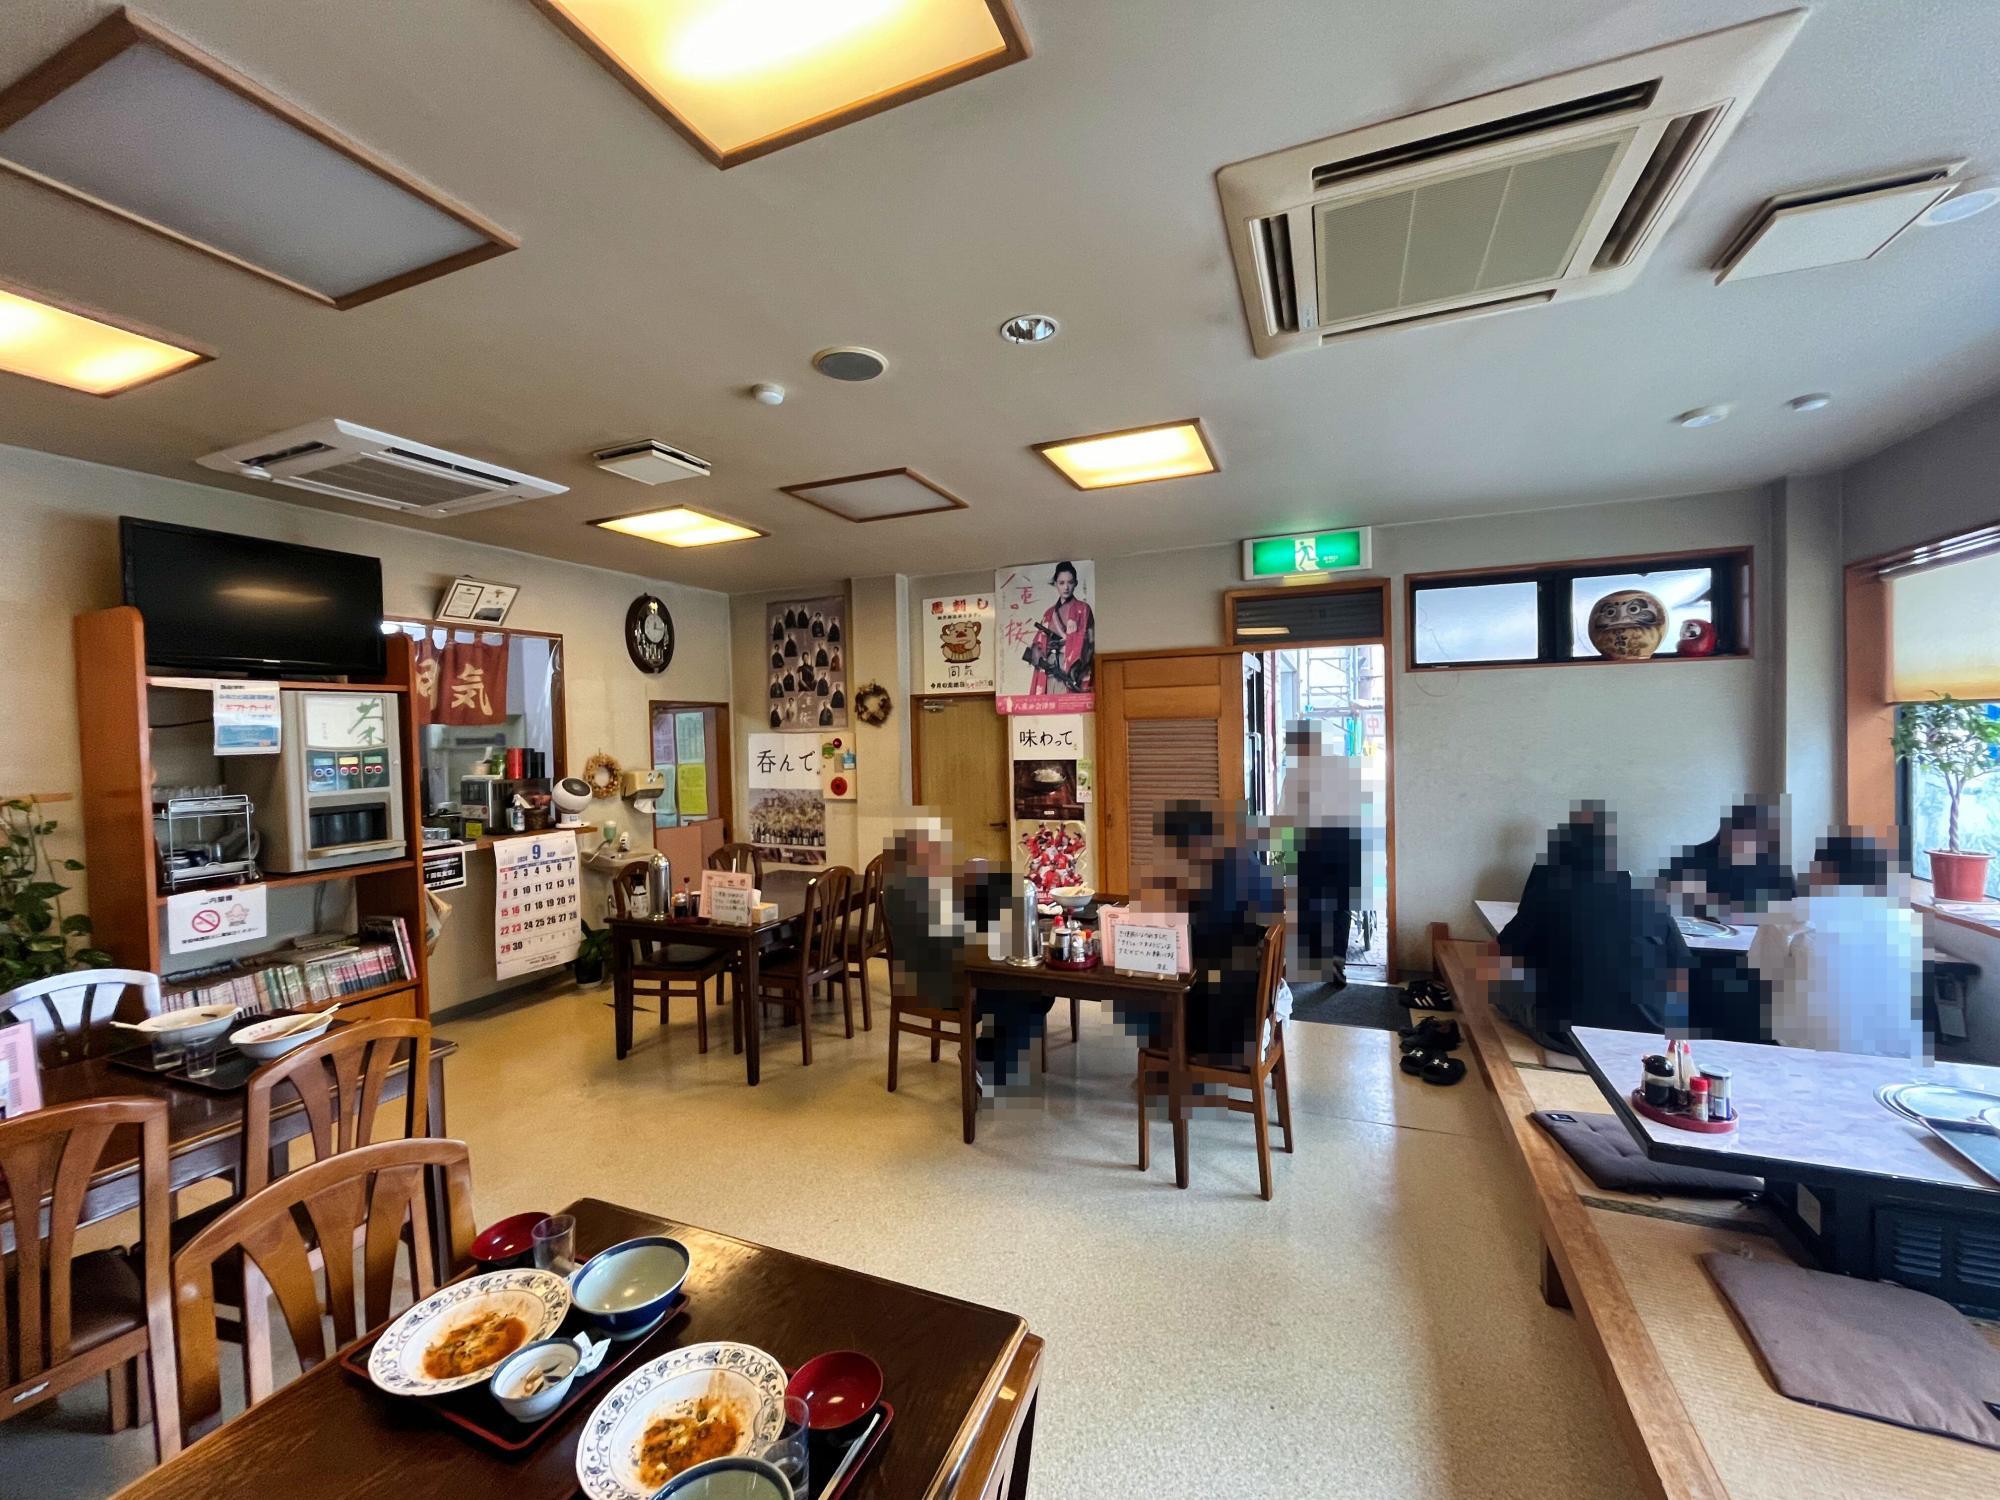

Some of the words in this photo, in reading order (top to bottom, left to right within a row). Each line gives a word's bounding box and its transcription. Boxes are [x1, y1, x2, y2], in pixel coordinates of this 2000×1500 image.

[931, 598, 989, 615] 馬刺し
[532, 844, 541, 860] 9
[513, 870, 518, 879] 2
[523, 868, 528, 877] 3
[535, 866, 540, 874] 4
[546, 864, 551, 873] 5
[557, 863, 562, 871] 6
[569, 861, 572, 869] 7
[502, 890, 507, 899] 8
[513, 888, 518, 897] 9
[523, 885, 531, 894] 10
[535, 884, 541, 892] 11
[545, 881, 553, 890] 12
[557, 879, 564, 888] 13
[567, 877, 575, 886] 14
[501, 909, 508, 917] 15
[512, 905, 520, 915] 16
[524, 903, 531, 911] 17
[535, 901, 543, 910] 18
[546, 898, 554, 907] 19
[557, 896, 566, 905] 20
[568, 894, 576, 903] 21
[500, 926, 509, 935] 22
[511, 923, 521, 933] 23
[523, 920, 533, 930] 24
[535, 918, 545, 928] 25
[546, 915, 556, 925] 26
[558, 913, 567, 923] 27
[568, 910, 577, 920] 28
[500, 944, 511, 953] 29
[512, 941, 523, 951] 30
